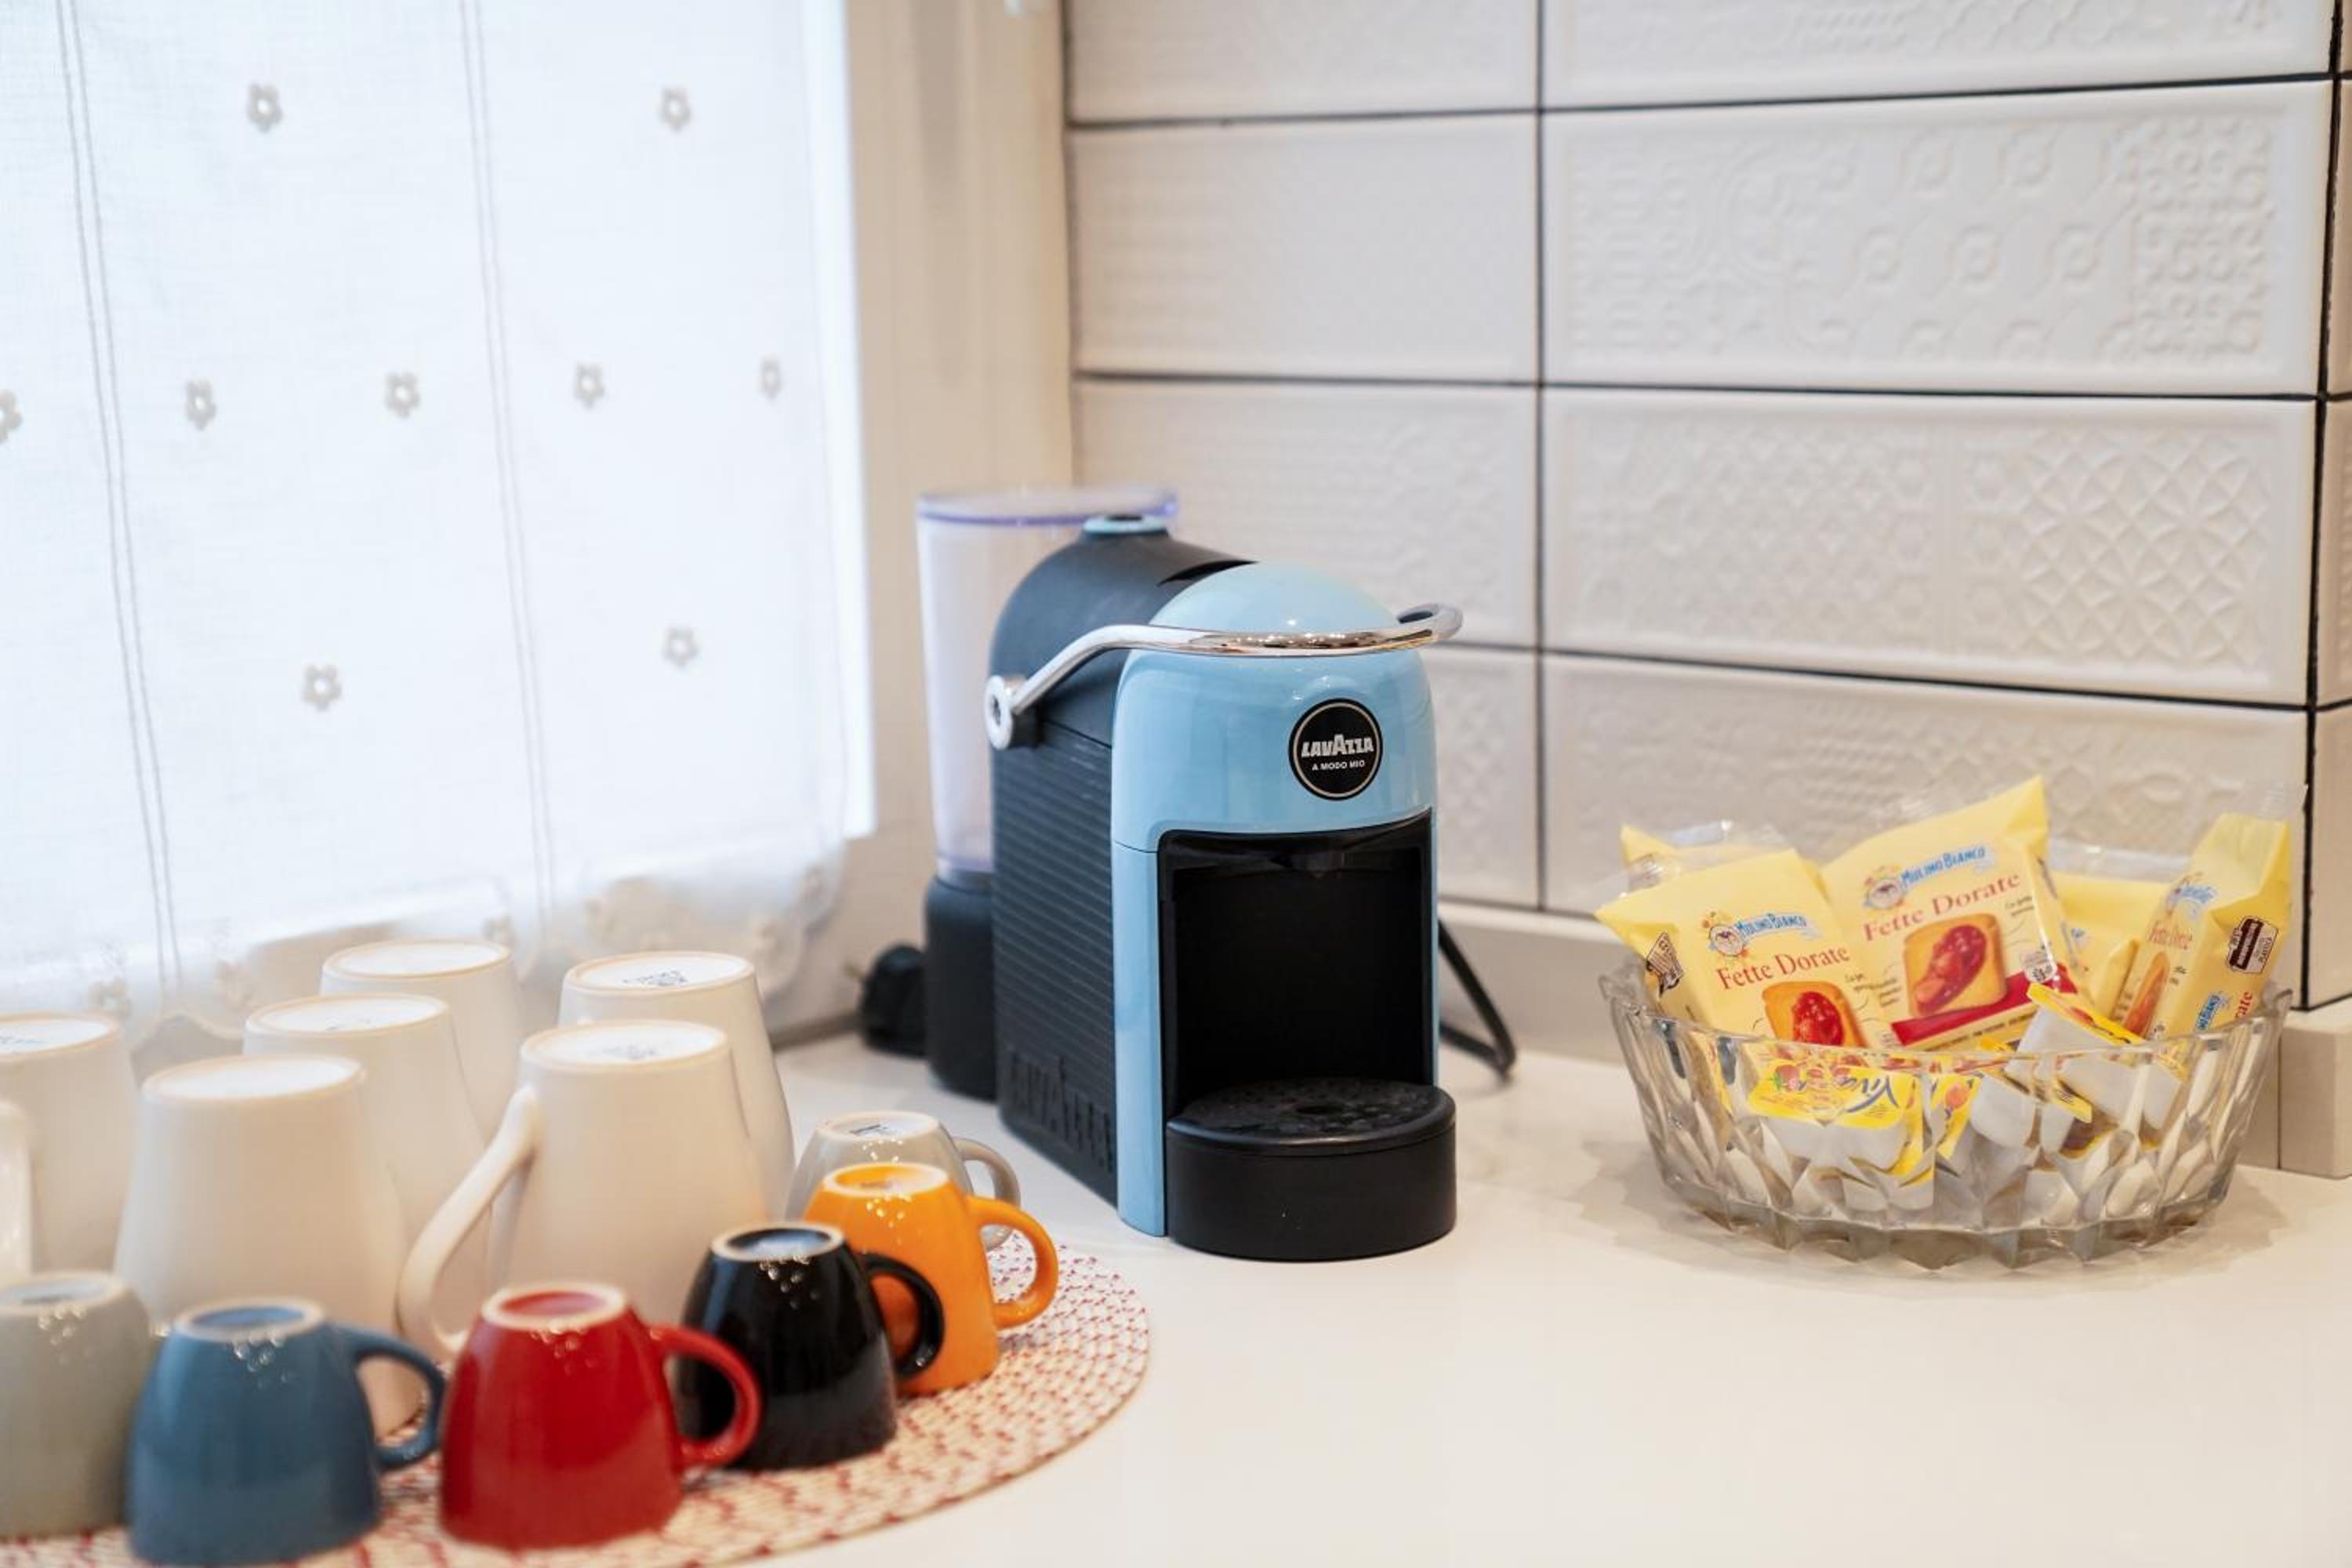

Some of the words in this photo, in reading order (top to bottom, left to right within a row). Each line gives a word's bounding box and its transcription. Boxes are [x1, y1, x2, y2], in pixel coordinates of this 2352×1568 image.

[1301, 734, 1374, 757] LAVAZZA
[1320, 761, 1348, 771] MODO
[1350, 760, 1366, 768] MIO
[1863, 909, 1926, 942] Fette
[1931, 873, 2020, 916] Dorate
[1715, 964, 1774, 991] Fette
[1774, 946, 1850, 976] Dorate
